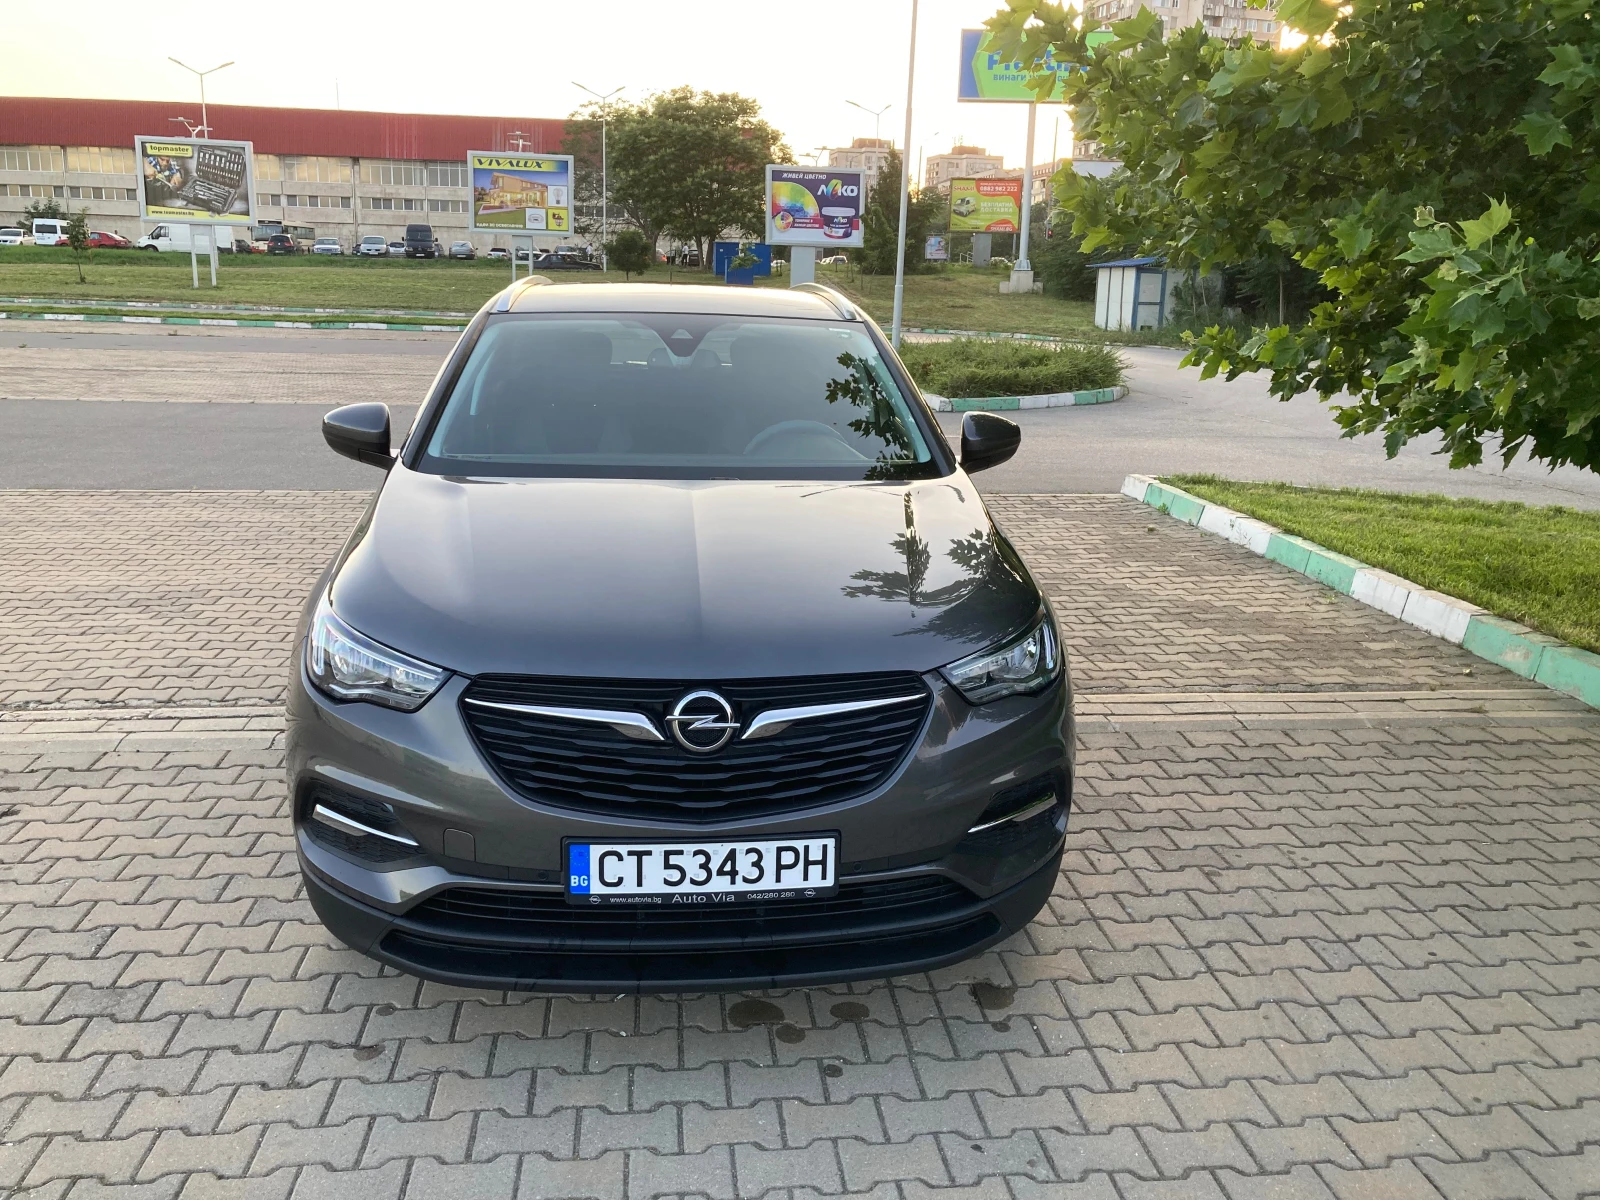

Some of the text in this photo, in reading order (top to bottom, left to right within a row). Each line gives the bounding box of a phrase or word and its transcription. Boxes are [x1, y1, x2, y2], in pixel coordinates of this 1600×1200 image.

[477, 158, 543, 168] VIVALUX
[663, 846, 765, 887] 5343
[570, 875, 588, 887] BG
[609, 896, 662, 904] www.autovia.bg
[672, 894, 707, 904] Auto
[711, 892, 735, 903] Via
[747, 892, 779, 900] 042/280
